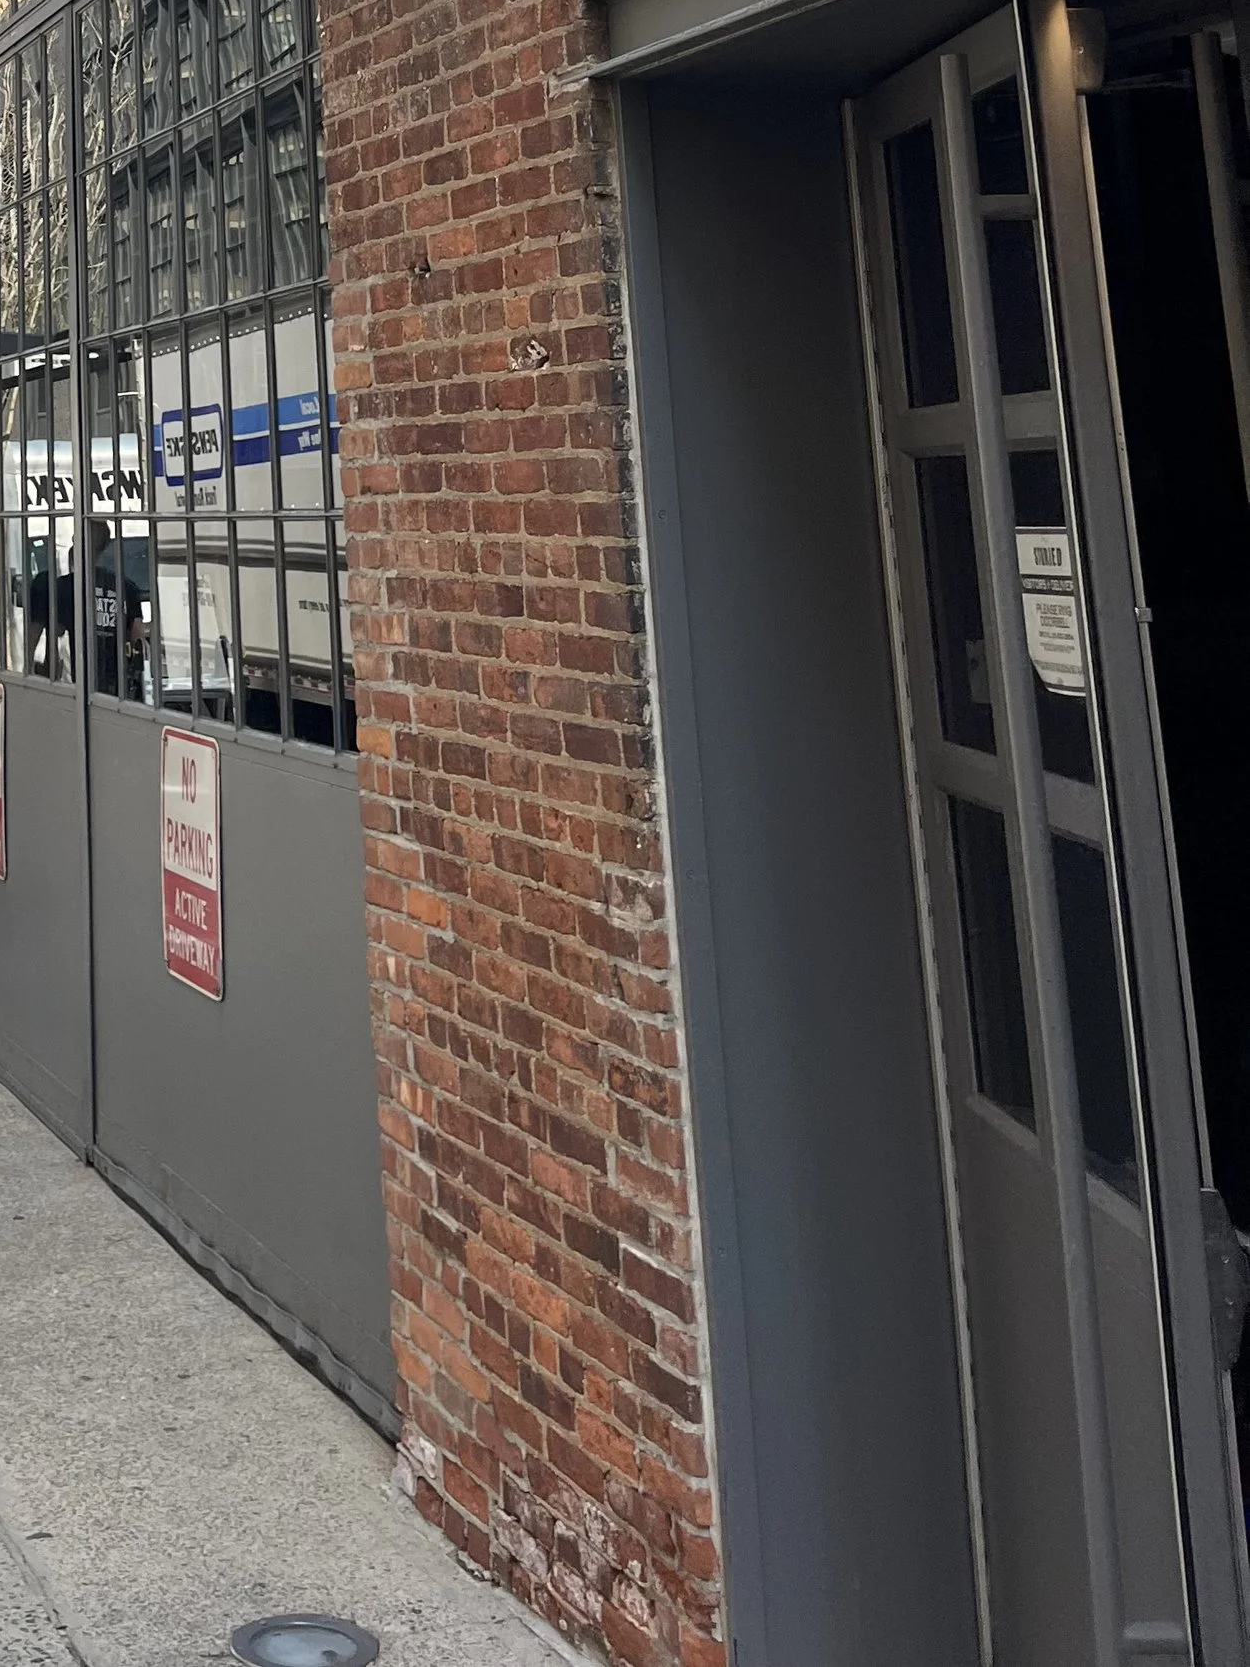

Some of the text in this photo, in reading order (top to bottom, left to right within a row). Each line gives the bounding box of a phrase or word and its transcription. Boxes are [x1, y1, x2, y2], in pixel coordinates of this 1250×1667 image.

[182, 755, 197, 804] NO
[166, 816, 214, 880] PARKING
[174, 887, 208, 932] ACTIVE
[168, 923, 216, 977] DRIVEWAY
